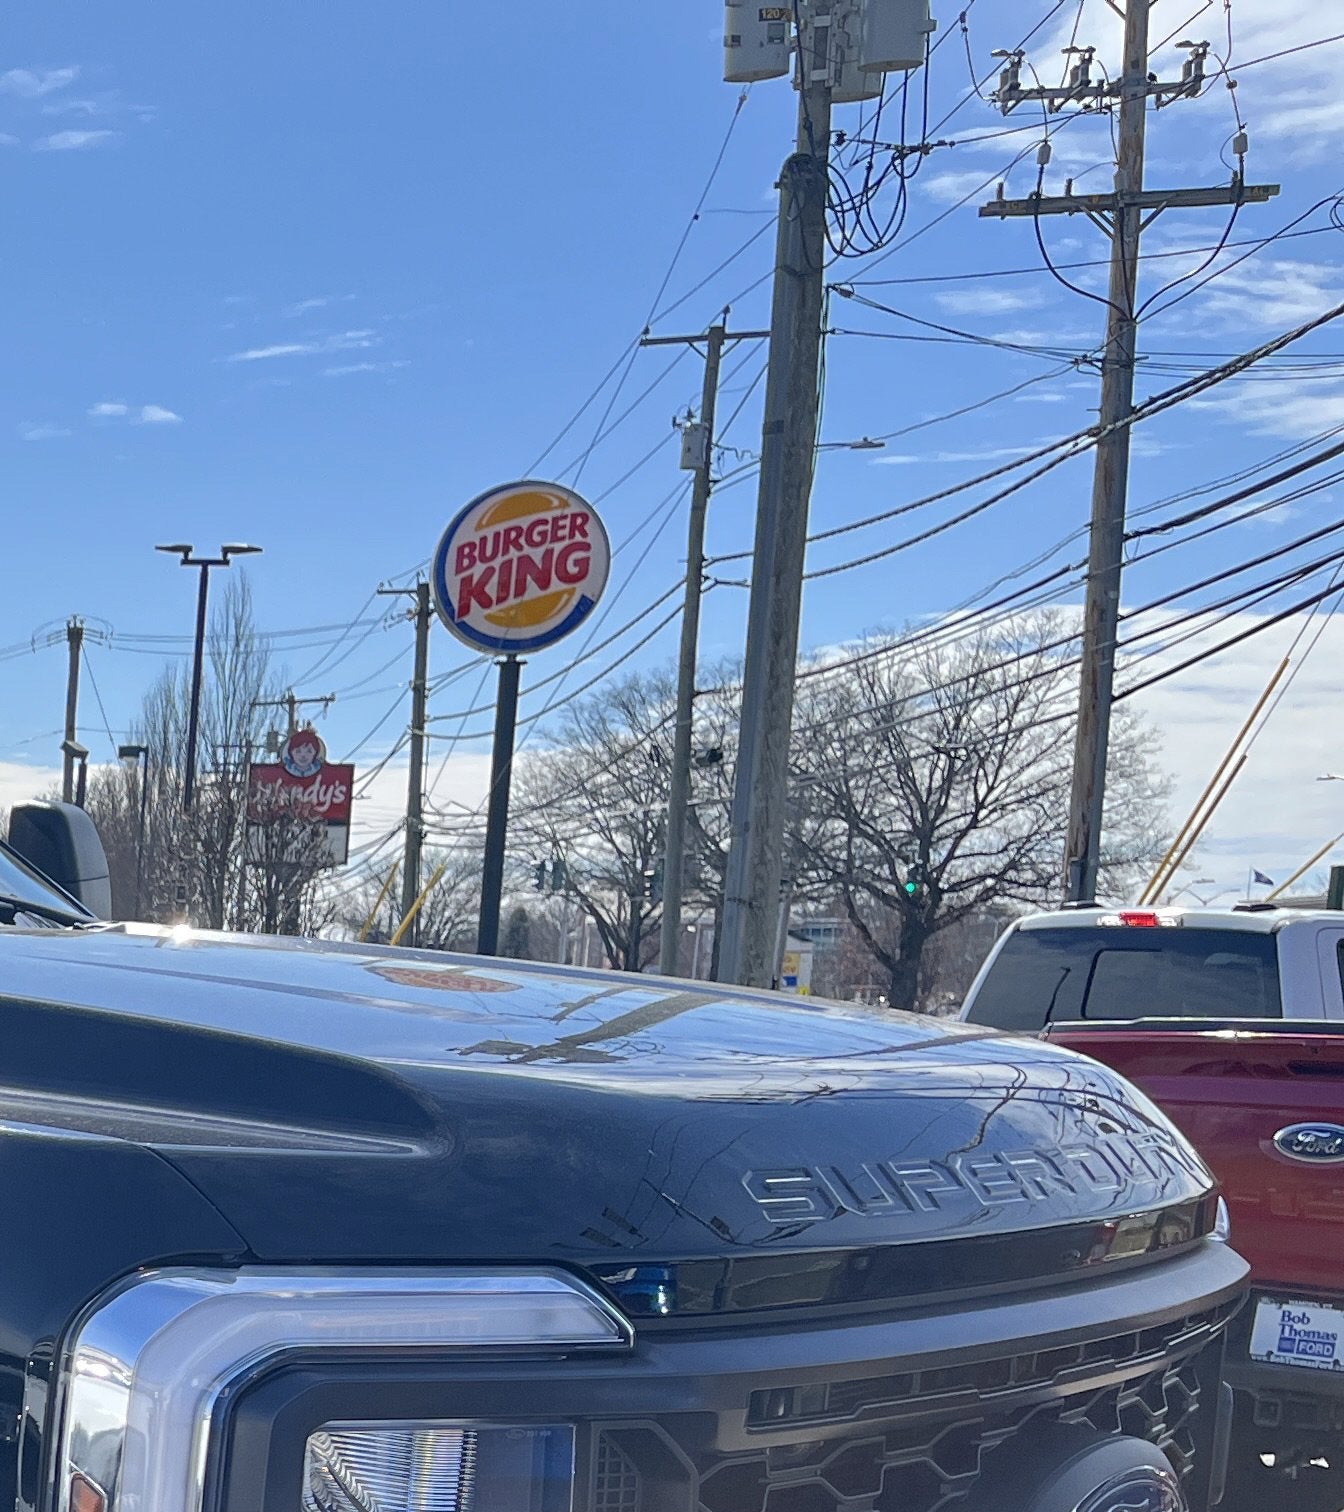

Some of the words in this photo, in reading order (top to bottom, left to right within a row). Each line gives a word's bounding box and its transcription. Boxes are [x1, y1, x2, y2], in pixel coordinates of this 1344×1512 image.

[455, 512, 590, 576] BURGER
[456, 541, 592, 619] KING
[1292, 1130, 1343, 1154] Ford
[1280, 1310, 1311, 1325] Bob
[1279, 1323, 1337, 1340] Thomas
[1299, 1341, 1332, 1355] FORD
